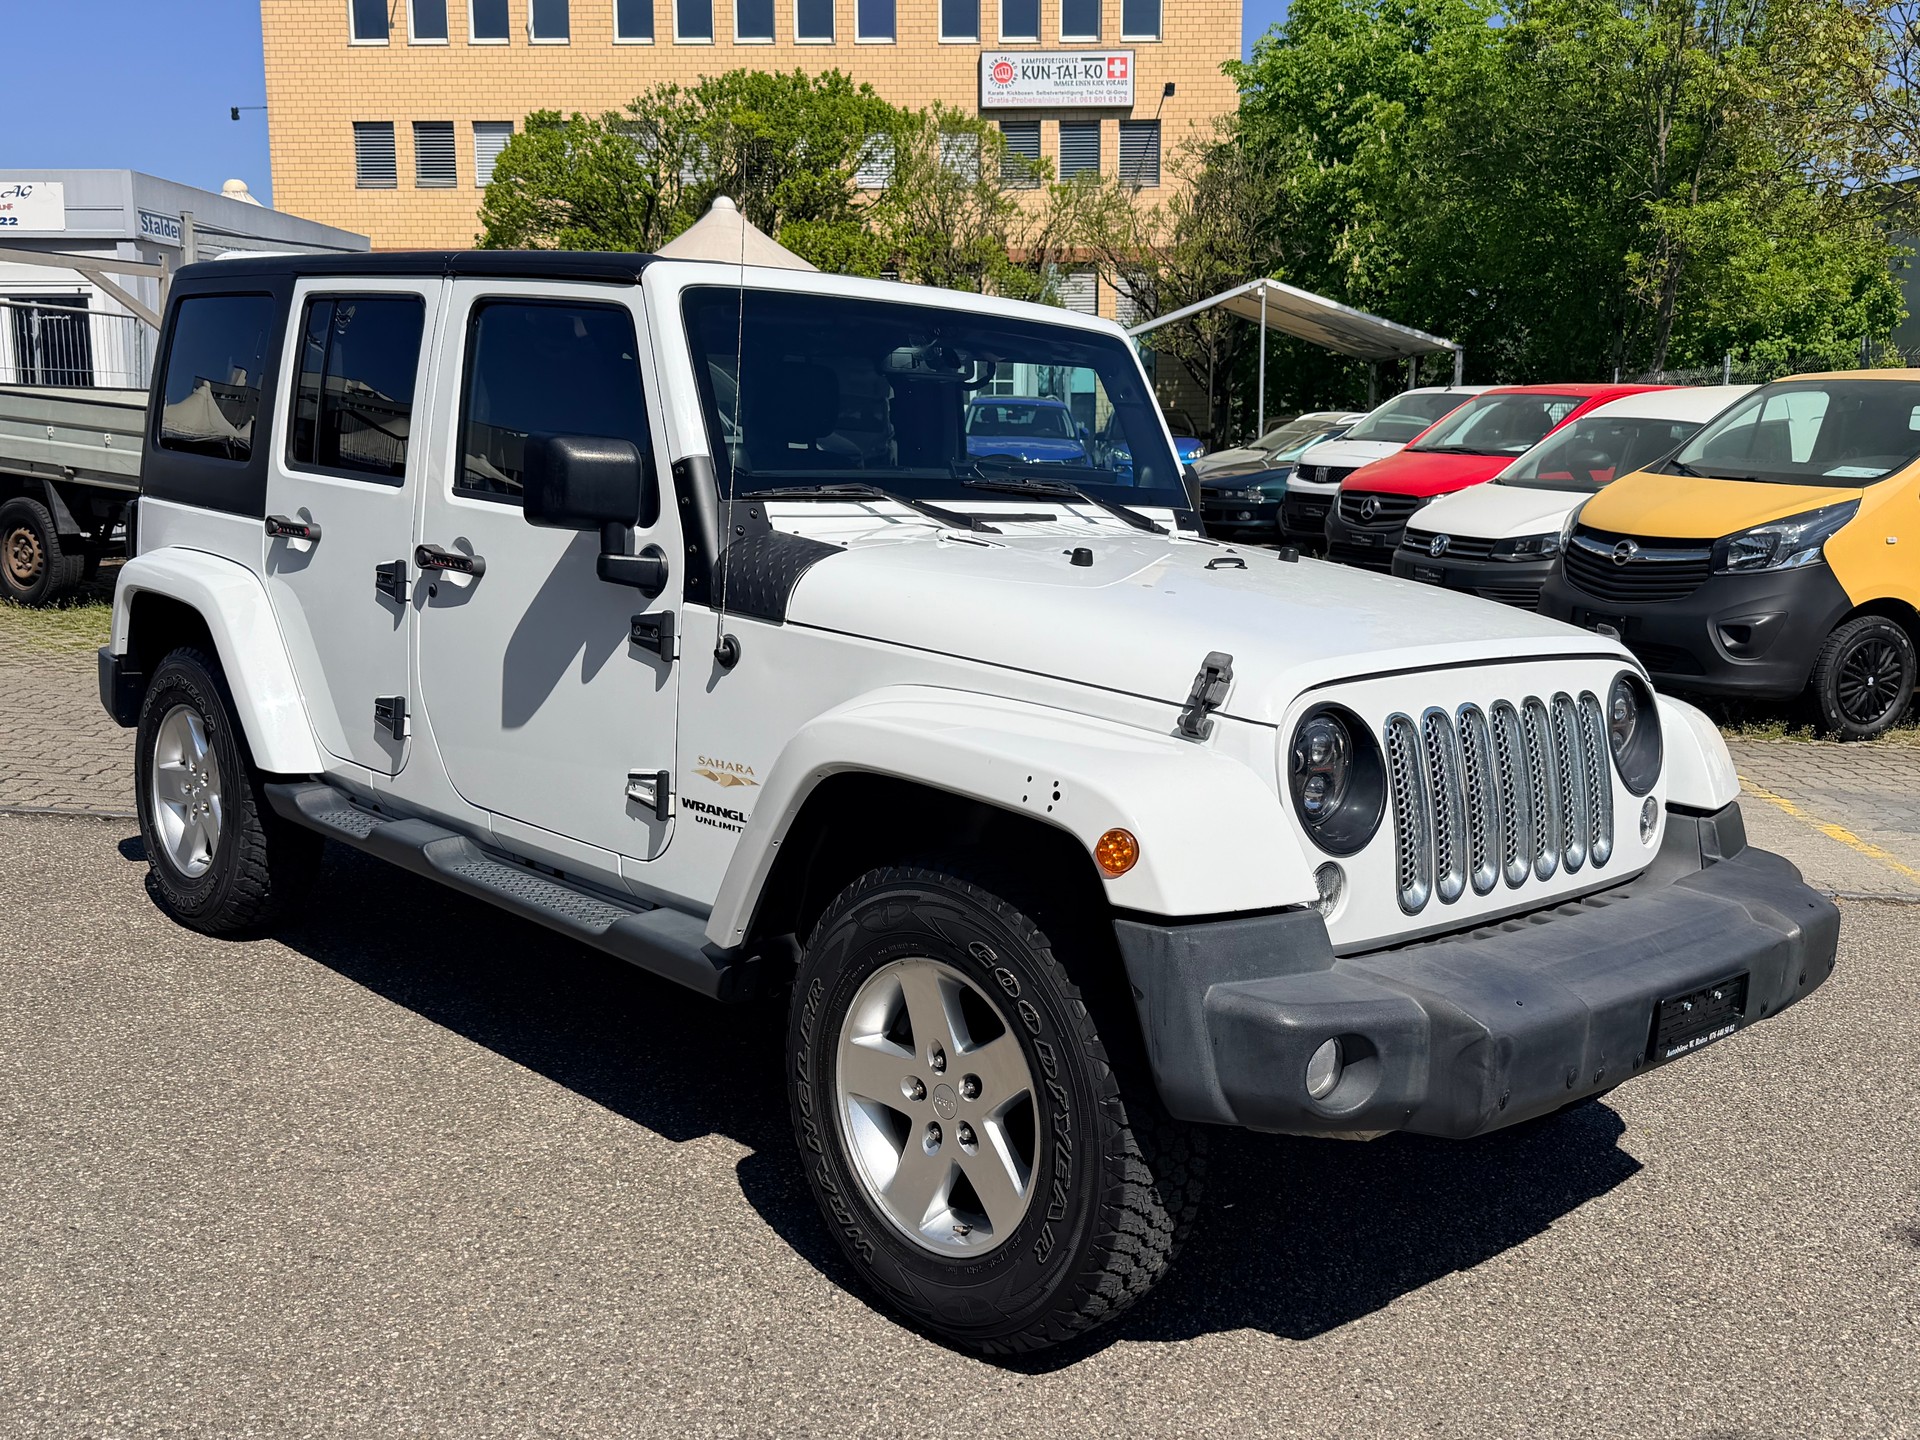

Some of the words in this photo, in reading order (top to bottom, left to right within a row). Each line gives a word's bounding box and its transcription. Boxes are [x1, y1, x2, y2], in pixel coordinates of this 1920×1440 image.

[1021, 64, 1103, 80] KUN-TAI-KO
[698, 755, 755, 776] SAHARA
[681, 796, 748, 824] WRANGL
[695, 815, 744, 834] UNLIMIT
[967, 940, 1073, 1265] GOODYEAR
[797, 976, 875, 1266] WRANGLER
